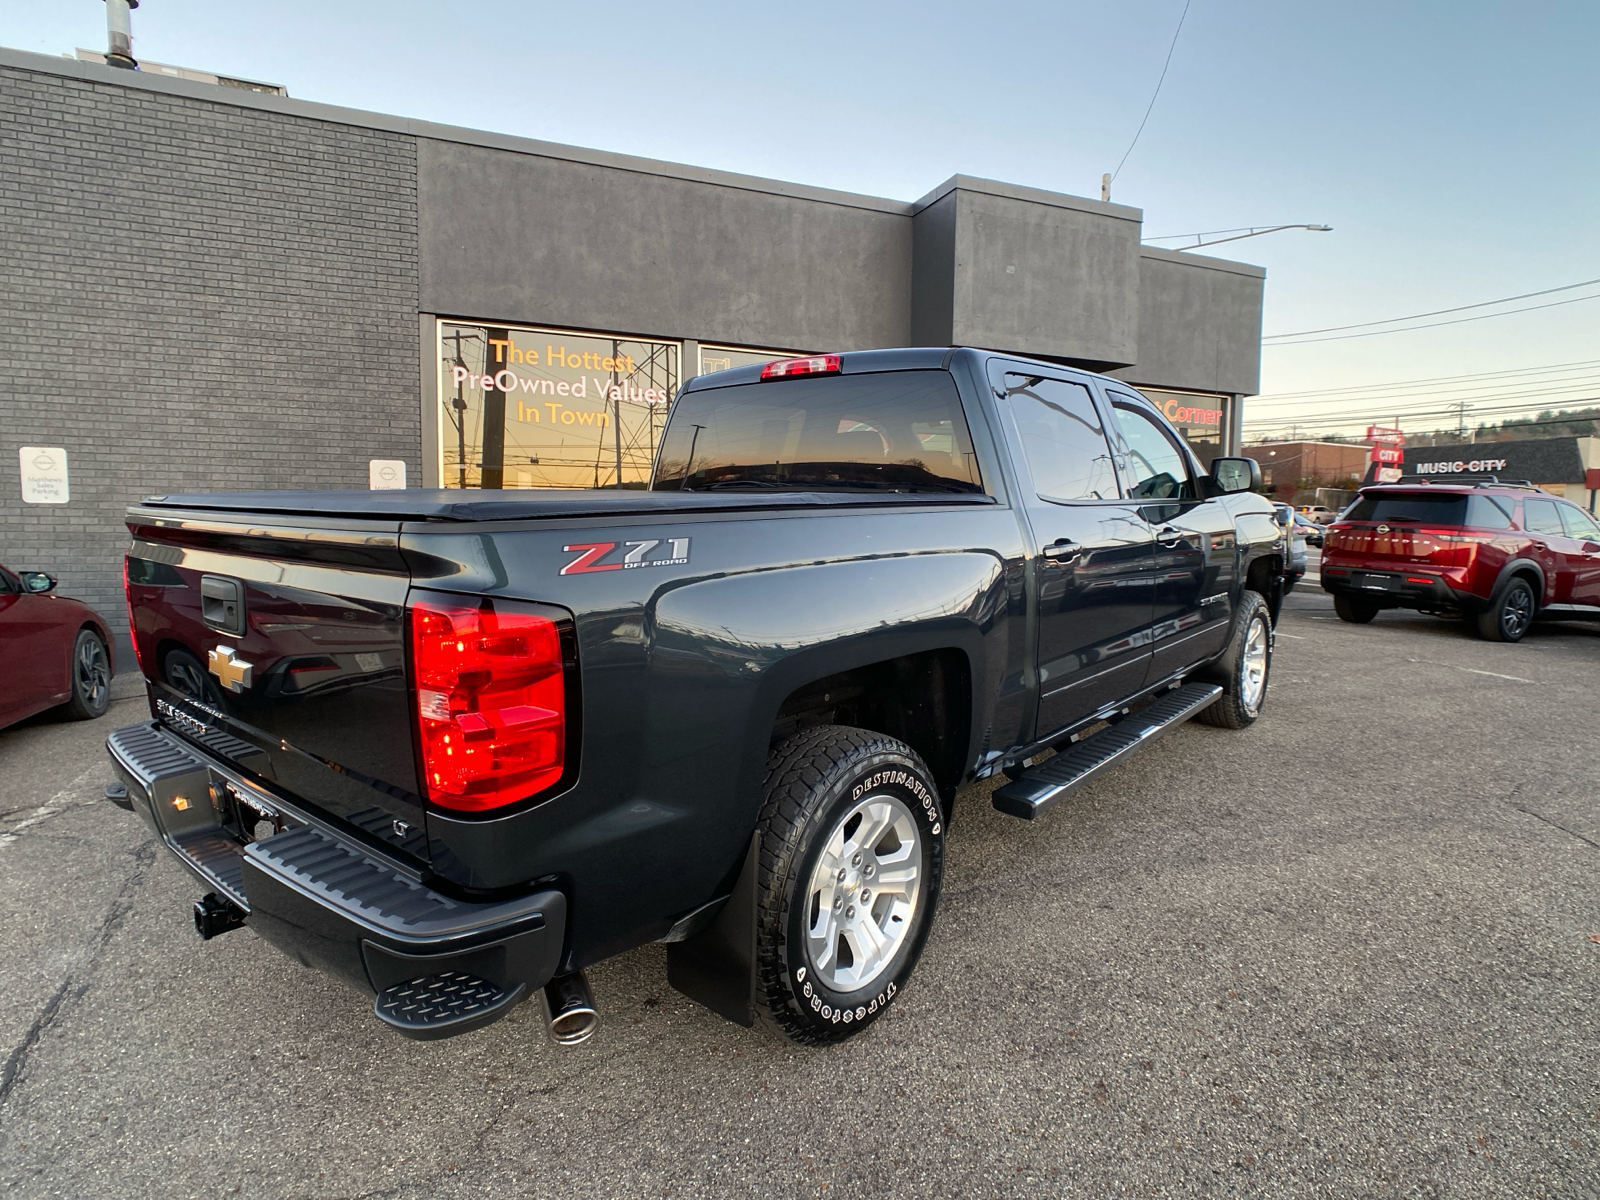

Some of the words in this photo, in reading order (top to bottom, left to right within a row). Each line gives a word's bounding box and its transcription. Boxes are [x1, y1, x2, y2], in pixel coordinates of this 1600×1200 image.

[488, 338, 539, 365] The
[546, 344, 635, 373] Hottest
[452, 365, 587, 398] PreOwned
[593, 377, 667, 404] Values
[517, 400, 540, 423] In
[544, 402, 610, 428] Town
[1163, 399, 1222, 426] Corner
[1379, 449, 1400, 462] CITY
[1416, 461, 1464, 474] MUSIC
[1468, 459, 1506, 472] CITY
[559, 537, 691, 576] Z71
[653, 558, 688, 566] ROAD
[852, 770, 937, 822] DESTINATION
[803, 981, 897, 1024] Firestone
